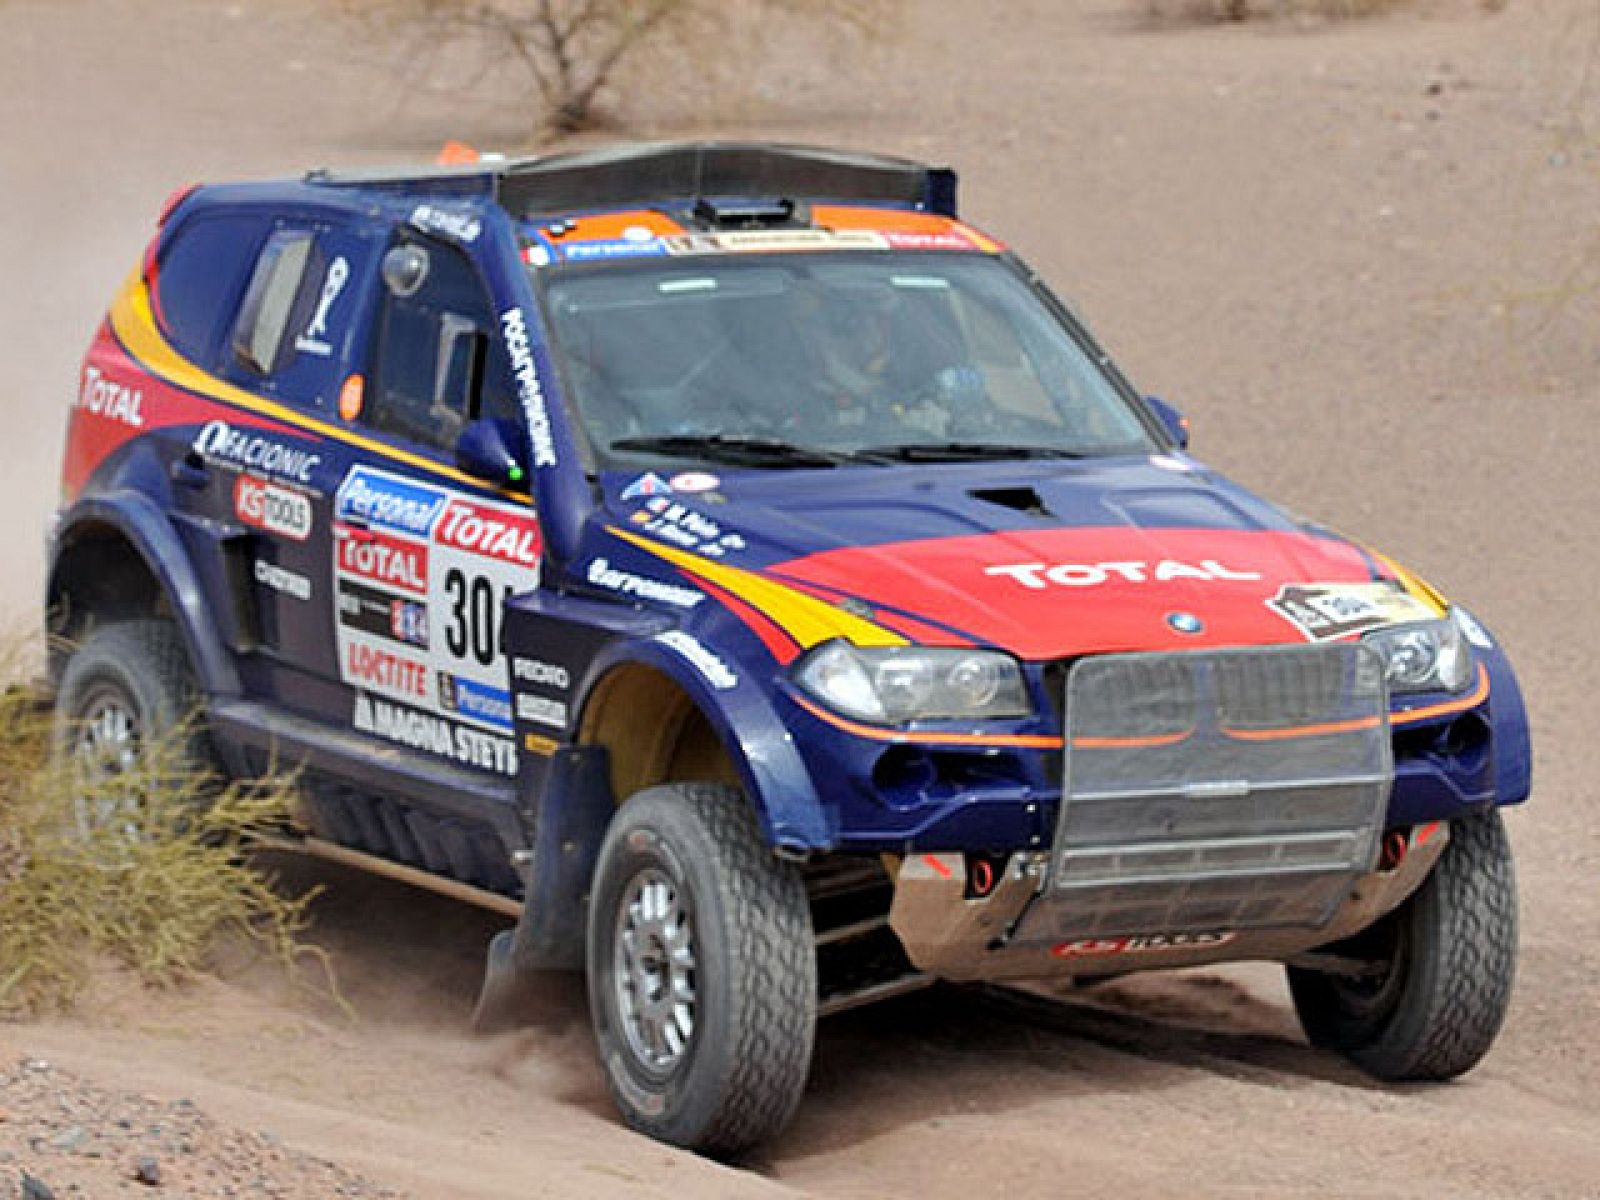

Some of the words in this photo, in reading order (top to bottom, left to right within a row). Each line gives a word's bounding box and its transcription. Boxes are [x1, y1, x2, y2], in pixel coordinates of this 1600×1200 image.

[81, 367, 144, 427] TOTAL
[339, 477, 444, 532] Personal
[444, 506, 536, 563] TOTAL
[342, 541, 426, 589] TOTAL
[985, 558, 1262, 590] TOTAL
[347, 642, 428, 696] LOCTITE
